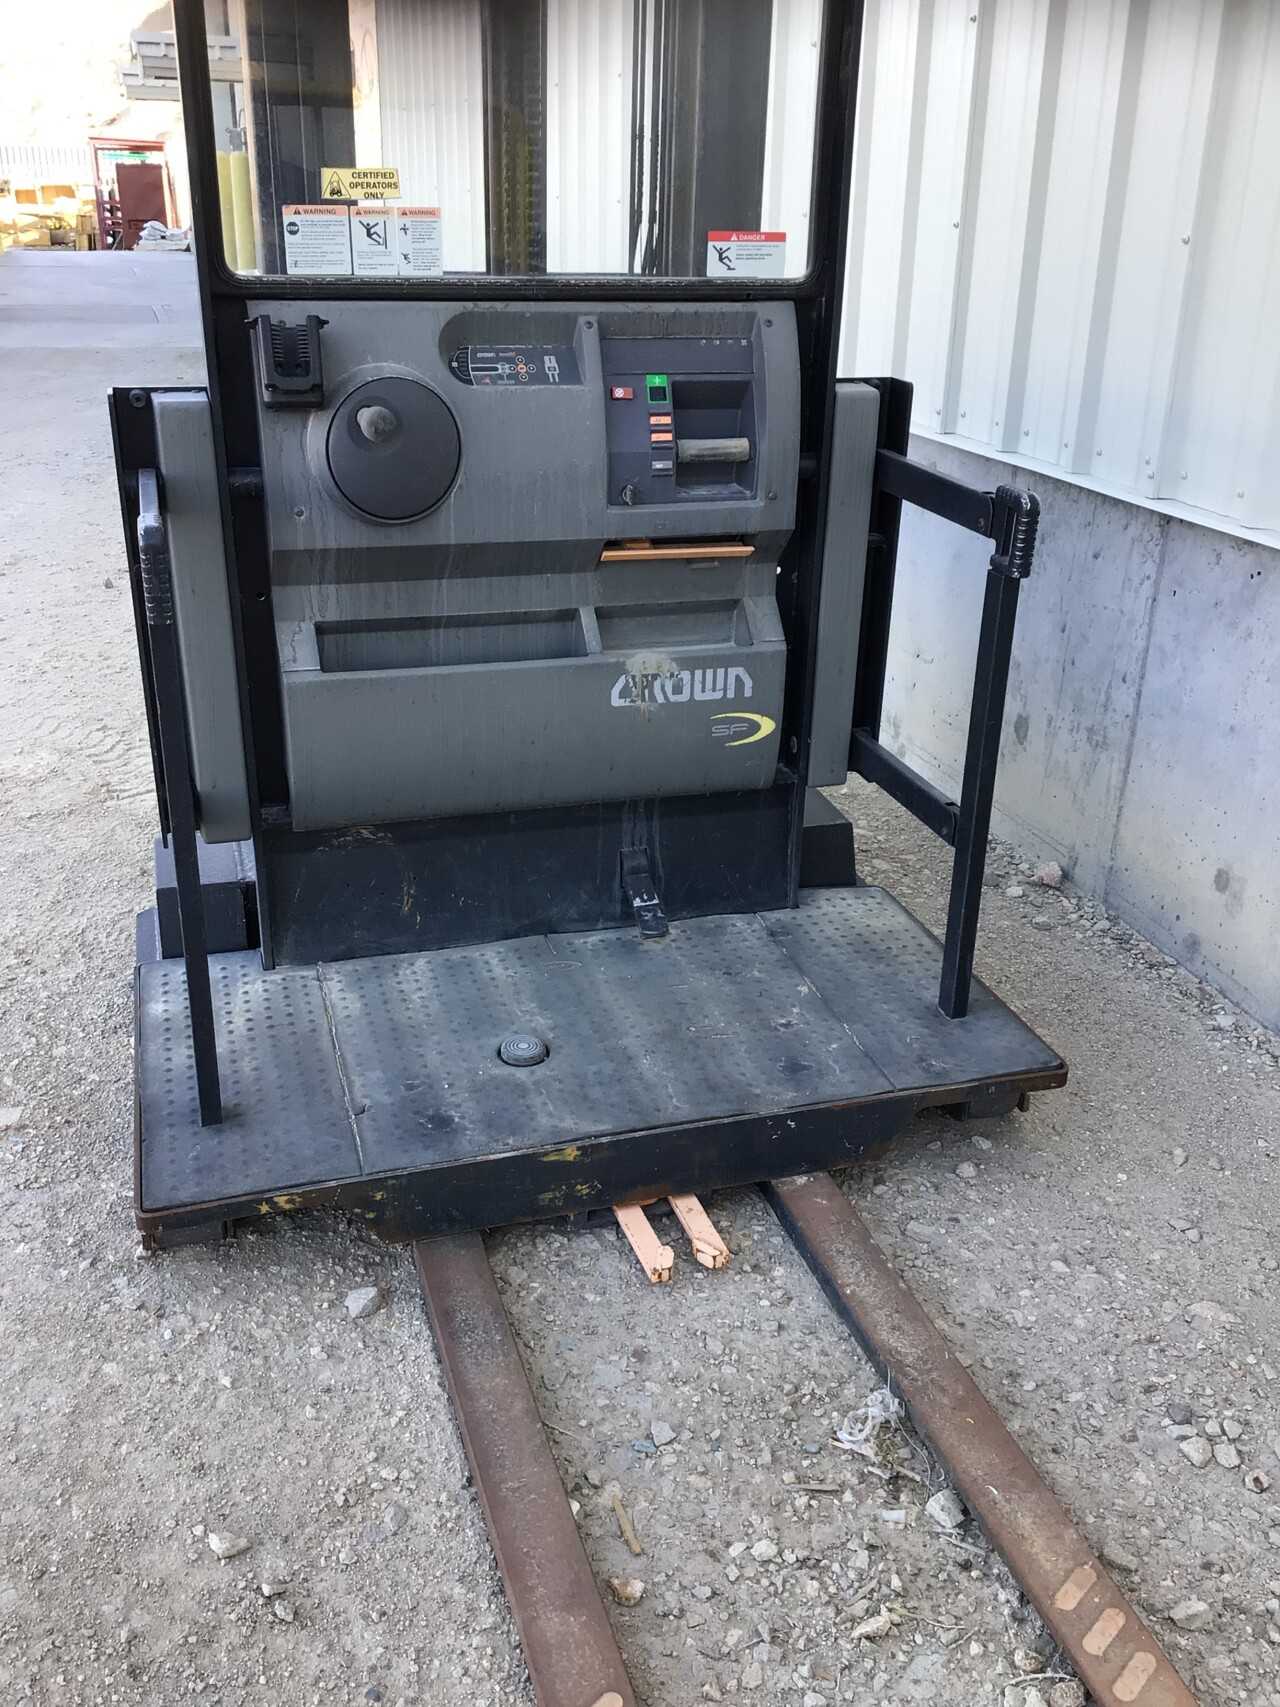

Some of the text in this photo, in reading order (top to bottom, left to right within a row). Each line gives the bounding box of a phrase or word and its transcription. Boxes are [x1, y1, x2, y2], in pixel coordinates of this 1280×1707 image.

[351, 171, 395, 180] CERTIFIED
[349, 181, 399, 190] OPERATORS
[363, 191, 385, 200] ONLY
[303, 208, 337, 216] WARNING
